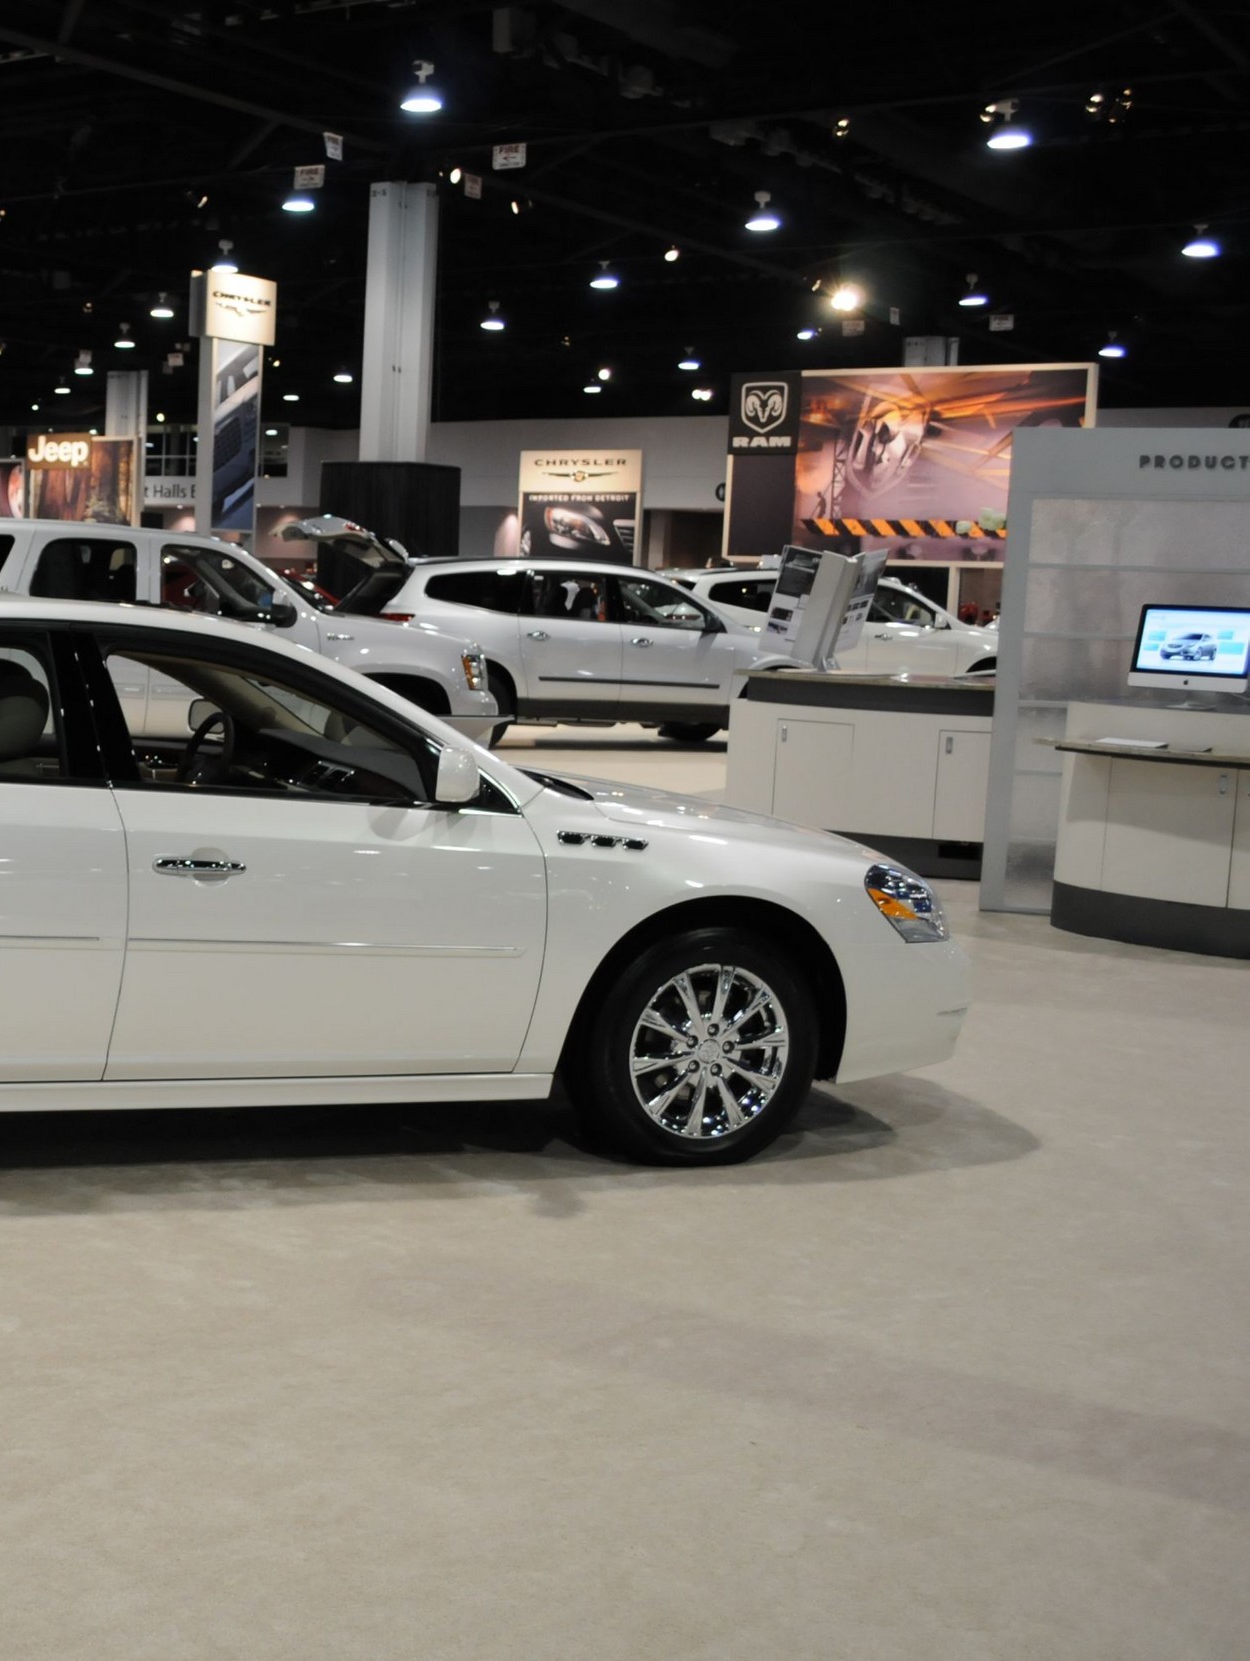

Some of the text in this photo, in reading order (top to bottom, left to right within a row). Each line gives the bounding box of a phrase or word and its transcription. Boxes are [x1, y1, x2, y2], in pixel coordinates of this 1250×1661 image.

[499, 145, 519, 154] FIRE
[300, 167, 319, 176] FIRE
[212, 291, 271, 306] CHRYSLER
[732, 436, 791, 448] RAM
[27, 435, 89, 468] Jeep
[534, 458, 627, 467] CHRYSLER
[1139, 454, 1249, 469] PRODUCT
[153, 484, 186, 498] Halls
[529, 494, 629, 503] IMPORTED FROM DETROIT
